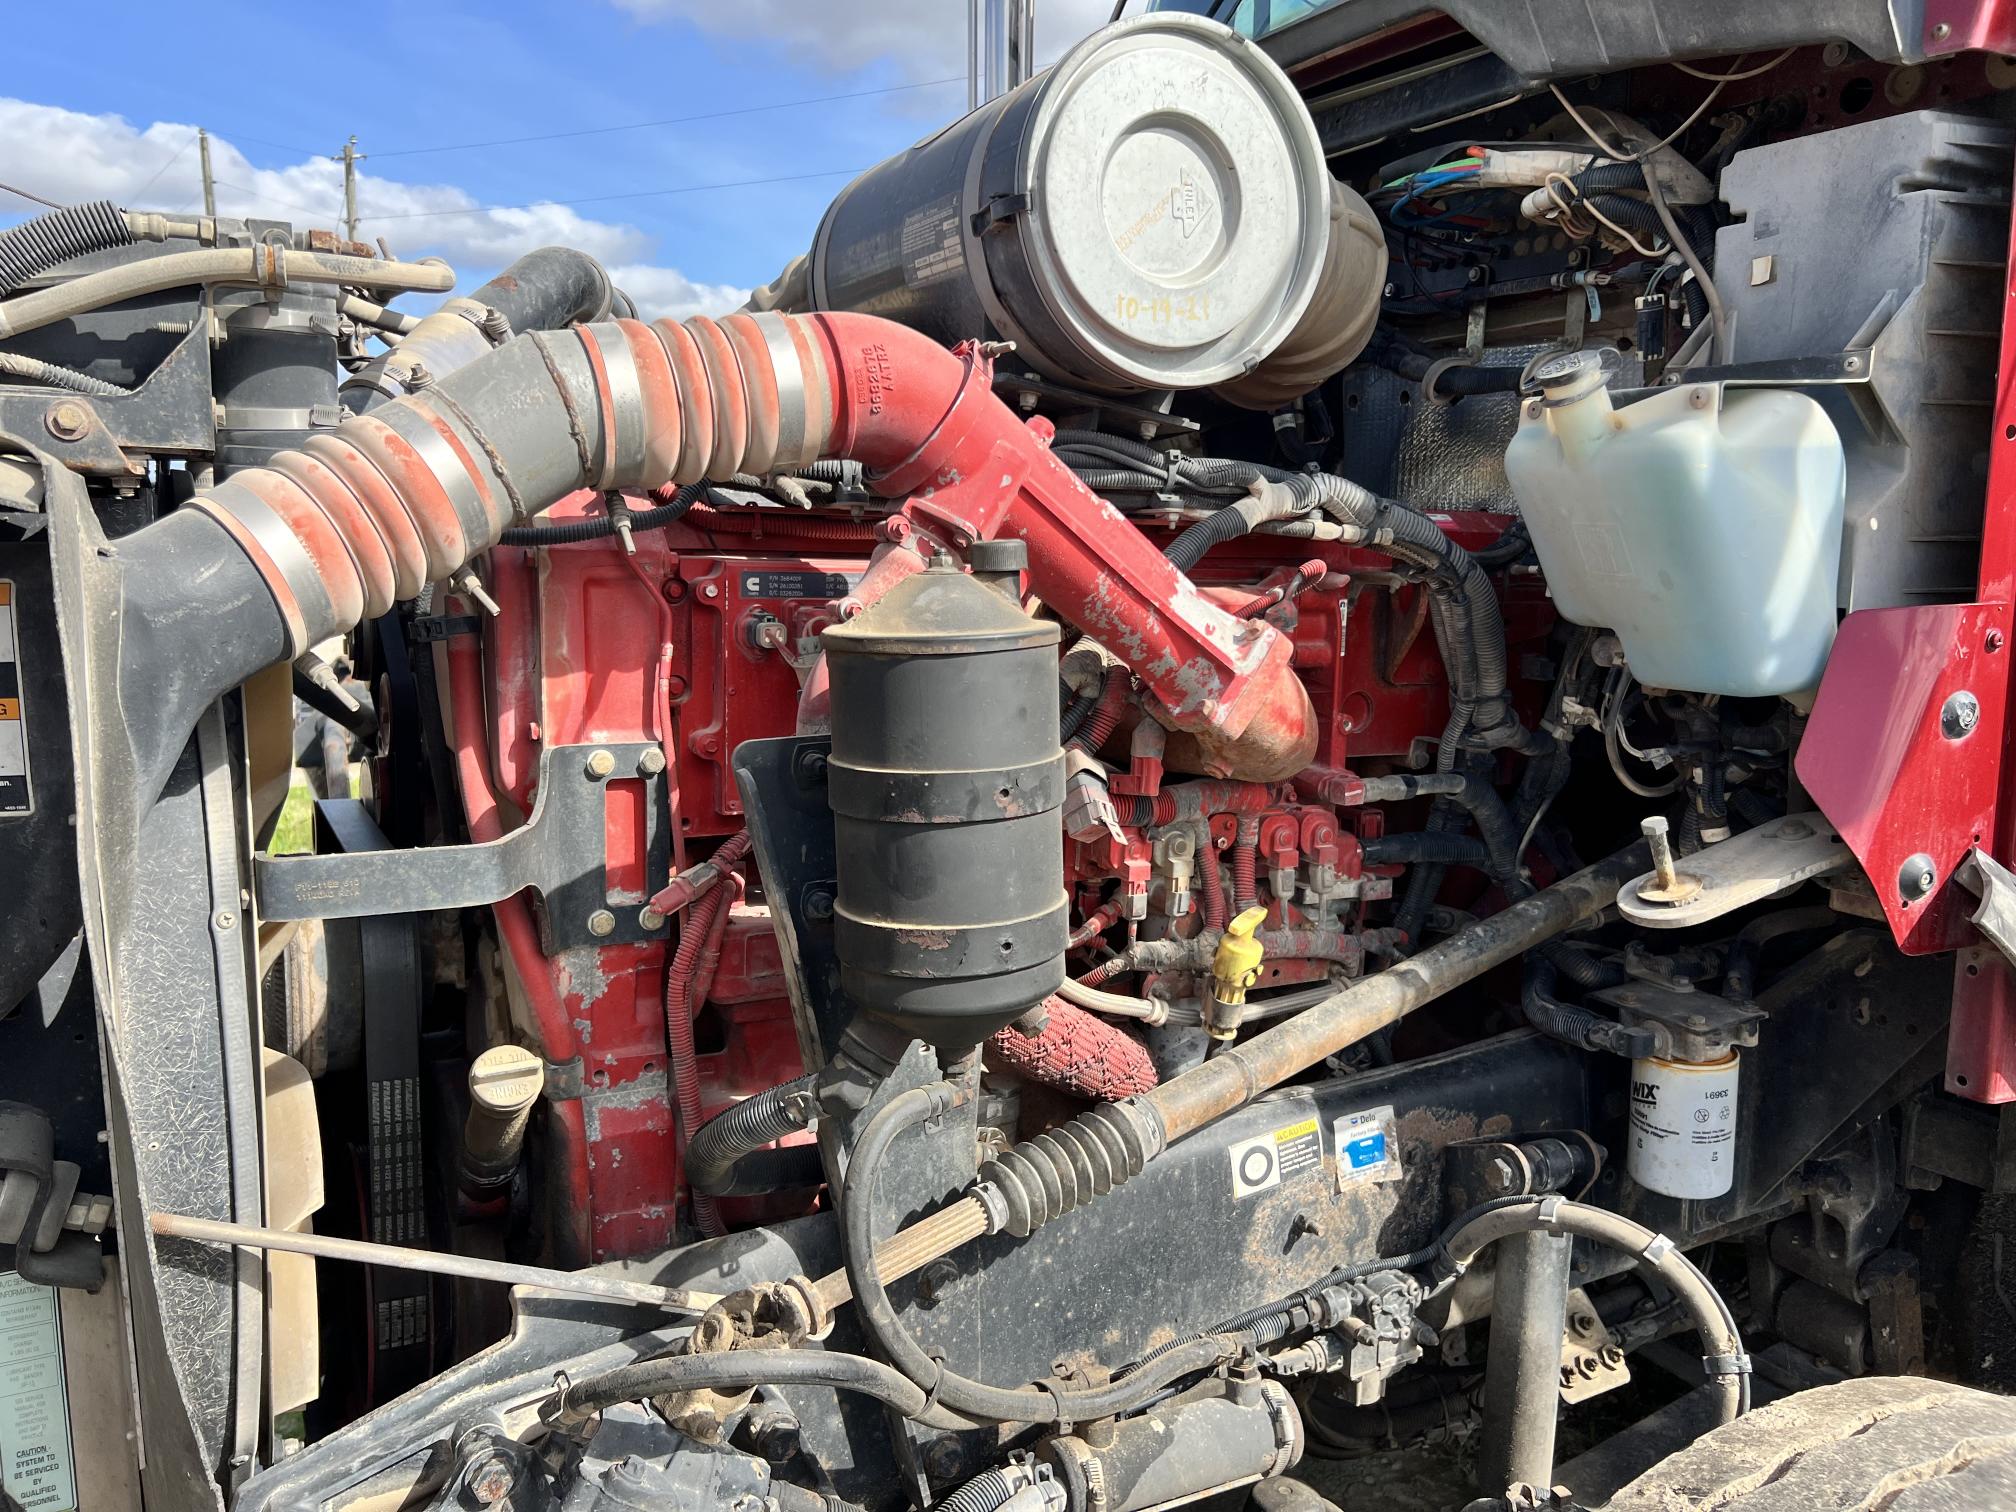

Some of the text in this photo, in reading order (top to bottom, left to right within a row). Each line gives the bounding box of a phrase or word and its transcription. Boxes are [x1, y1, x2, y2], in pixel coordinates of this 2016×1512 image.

[1184, 182, 1195, 222] INLET
[382, 1080, 392, 1123] DYNACRAFT
[1705, 1089, 1729, 1100] 33691
[1360, 1114, 1376, 1124] Delo
[1283, 1121, 1316, 1139] CAUTION
[16, 1453, 56, 1469] SYSTEM TO
[14, 1463, 60, 1480] BE SERVICED
[32, 1477, 42, 1486] BY
[20, 1485, 57, 1500] QUALIFIED
